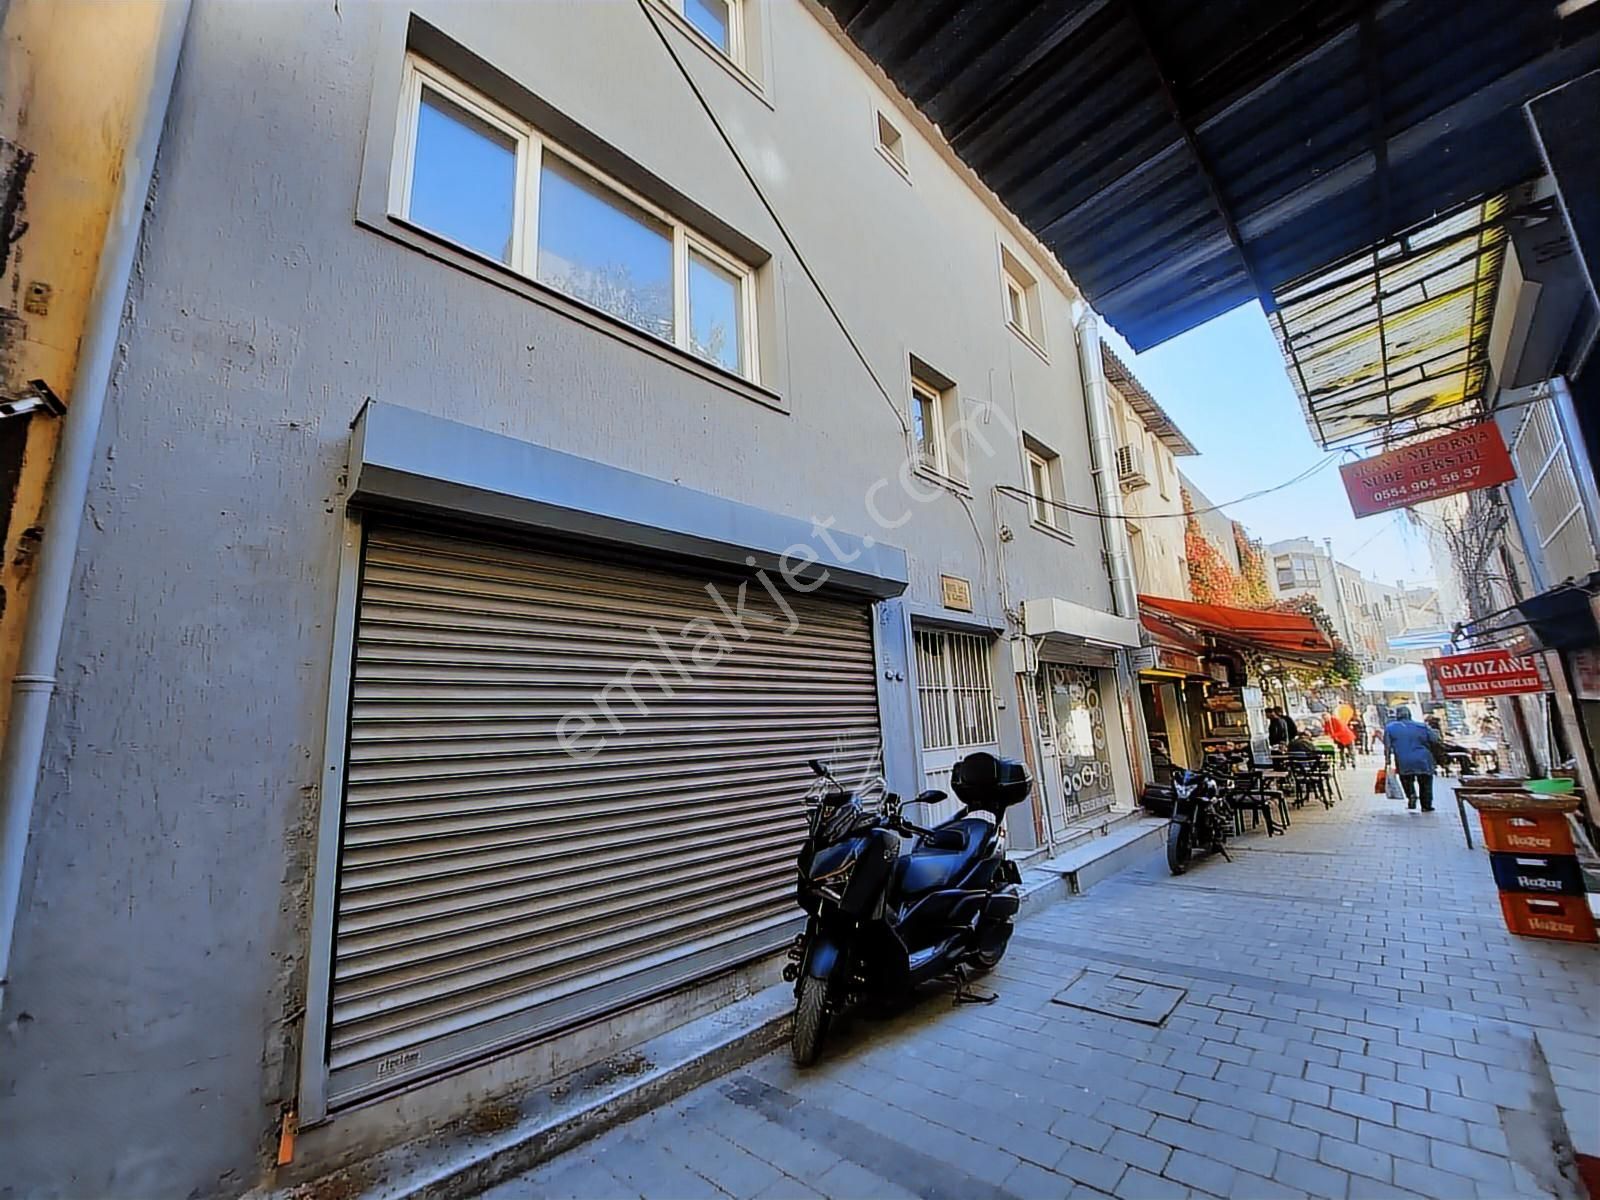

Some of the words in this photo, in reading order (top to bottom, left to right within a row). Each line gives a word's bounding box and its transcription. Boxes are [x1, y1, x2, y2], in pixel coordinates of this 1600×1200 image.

[1374, 486, 1407, 501] 0554
[1411, 478, 1437, 493] 904
[1440, 656, 1534, 679] GAZOZANE
